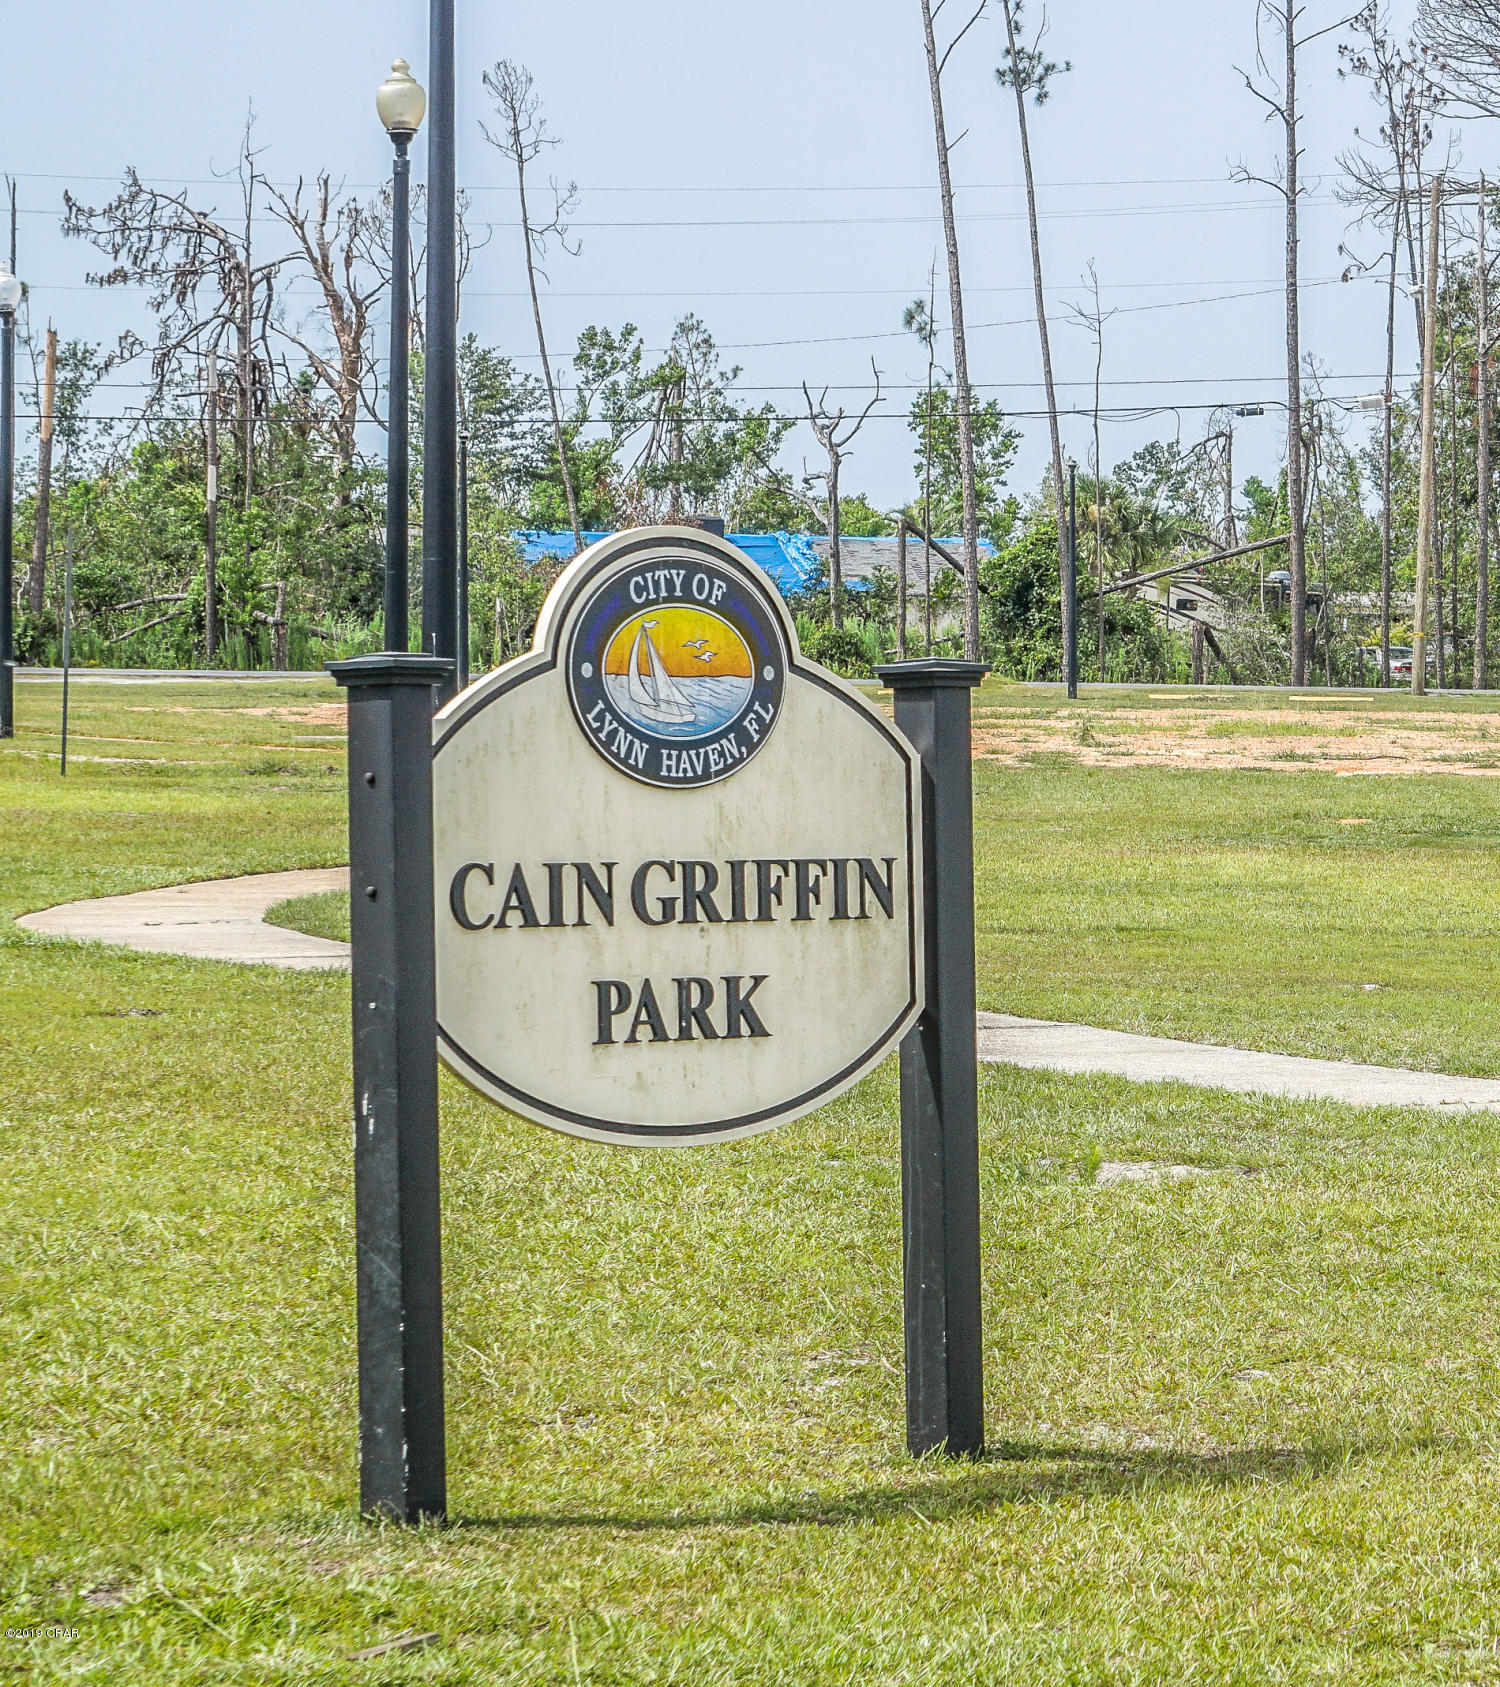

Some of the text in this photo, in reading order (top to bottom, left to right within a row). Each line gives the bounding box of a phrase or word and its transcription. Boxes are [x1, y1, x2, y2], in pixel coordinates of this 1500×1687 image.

[629, 570, 727, 606] CITY OF
[586, 700, 775, 778] LYNN HAVEN, FL
[449, 857, 898, 930] CAIN GRIFFIN
[591, 974, 772, 1045] PARK
